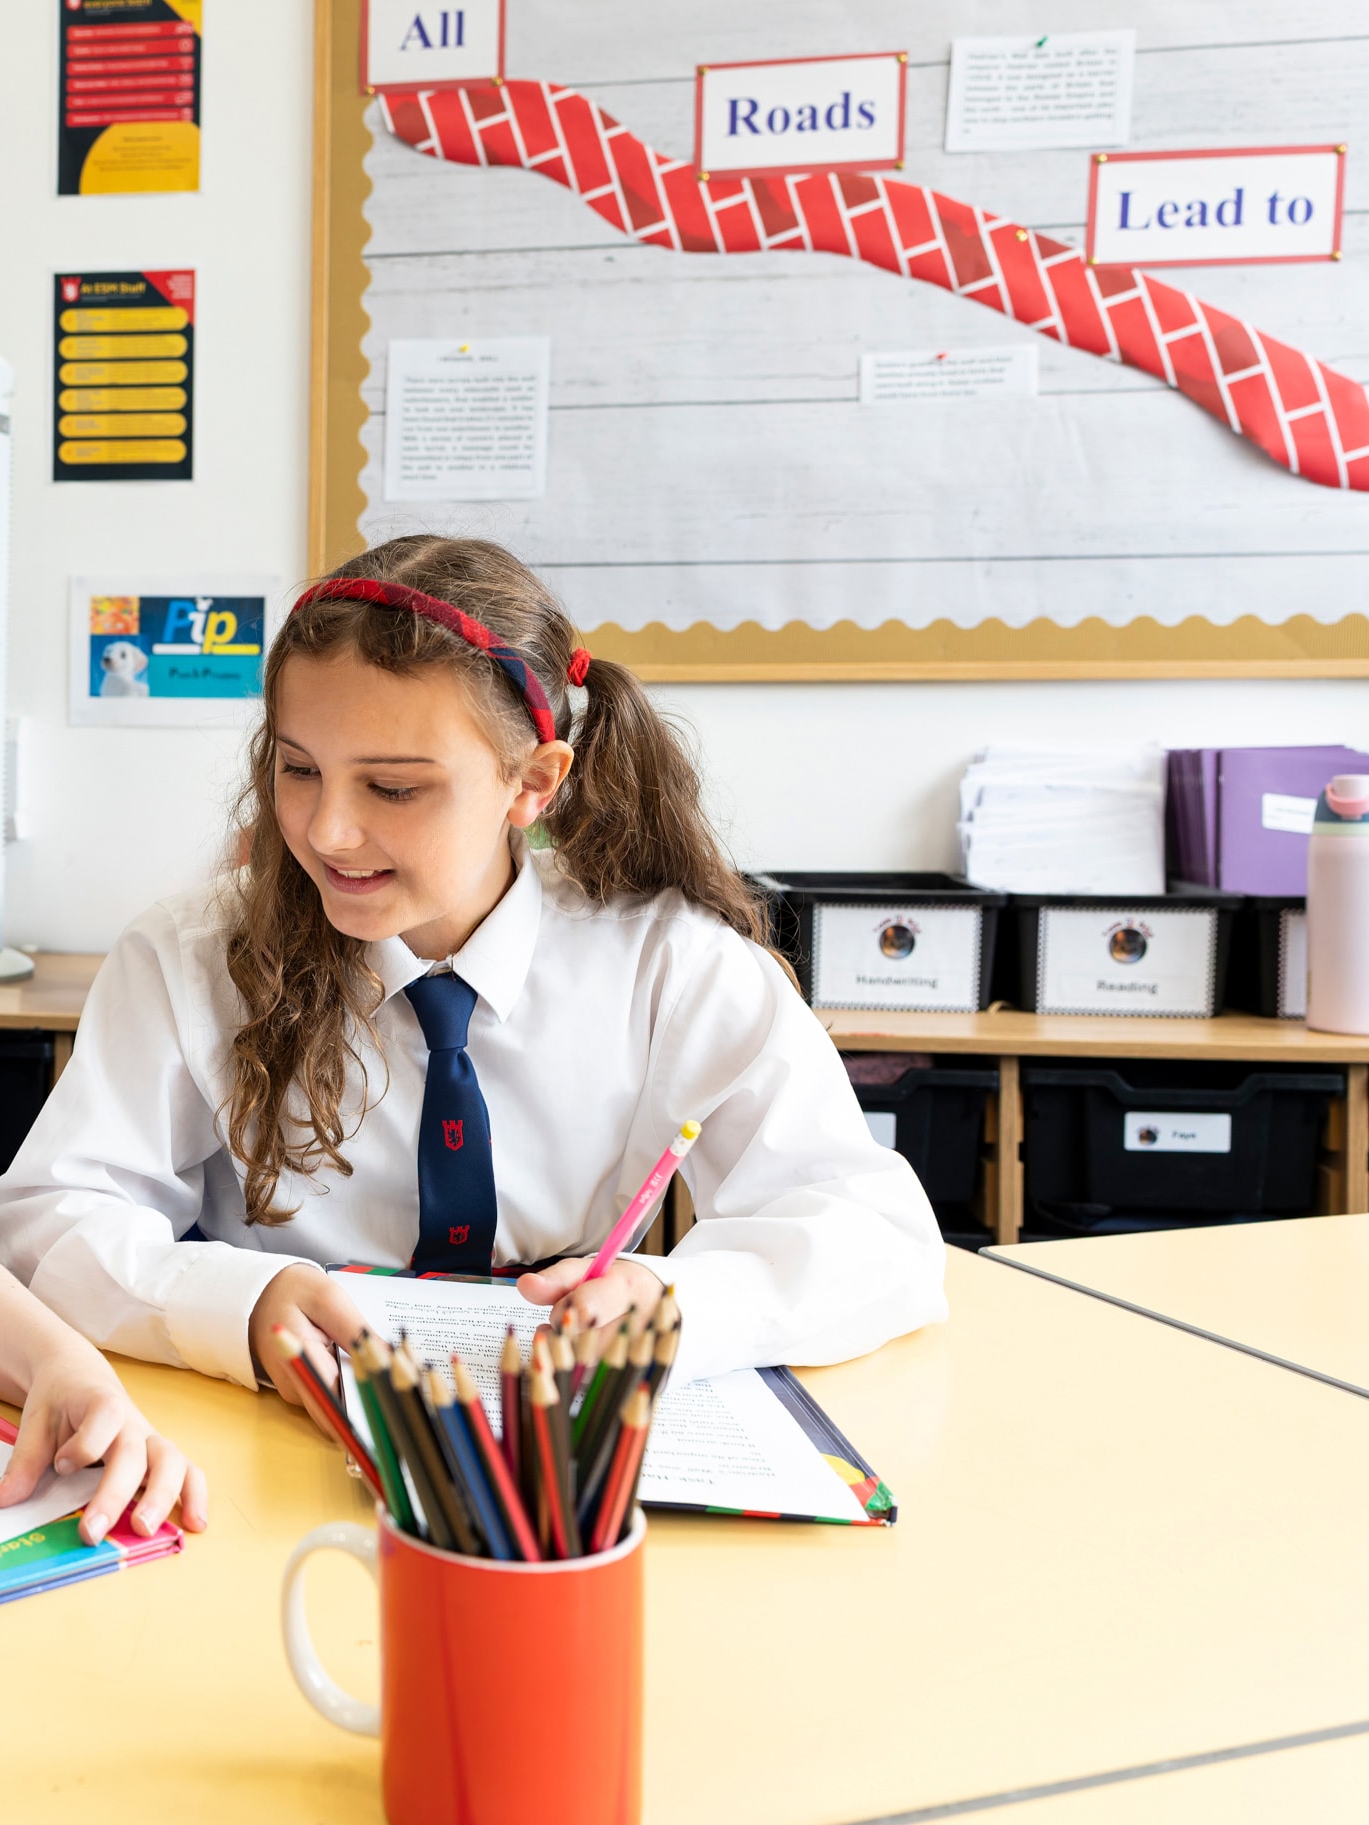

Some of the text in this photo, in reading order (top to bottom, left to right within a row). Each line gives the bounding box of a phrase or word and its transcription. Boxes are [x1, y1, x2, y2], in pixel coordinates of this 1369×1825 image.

[399, 10, 464, 50] All
[728, 91, 876, 136] Roads
[1118, 187, 1314, 230] Lead to
[162, 596, 238, 655] Pip
[856, 974, 938, 989] Handwriting
[1097, 979, 1159, 995] Reading
